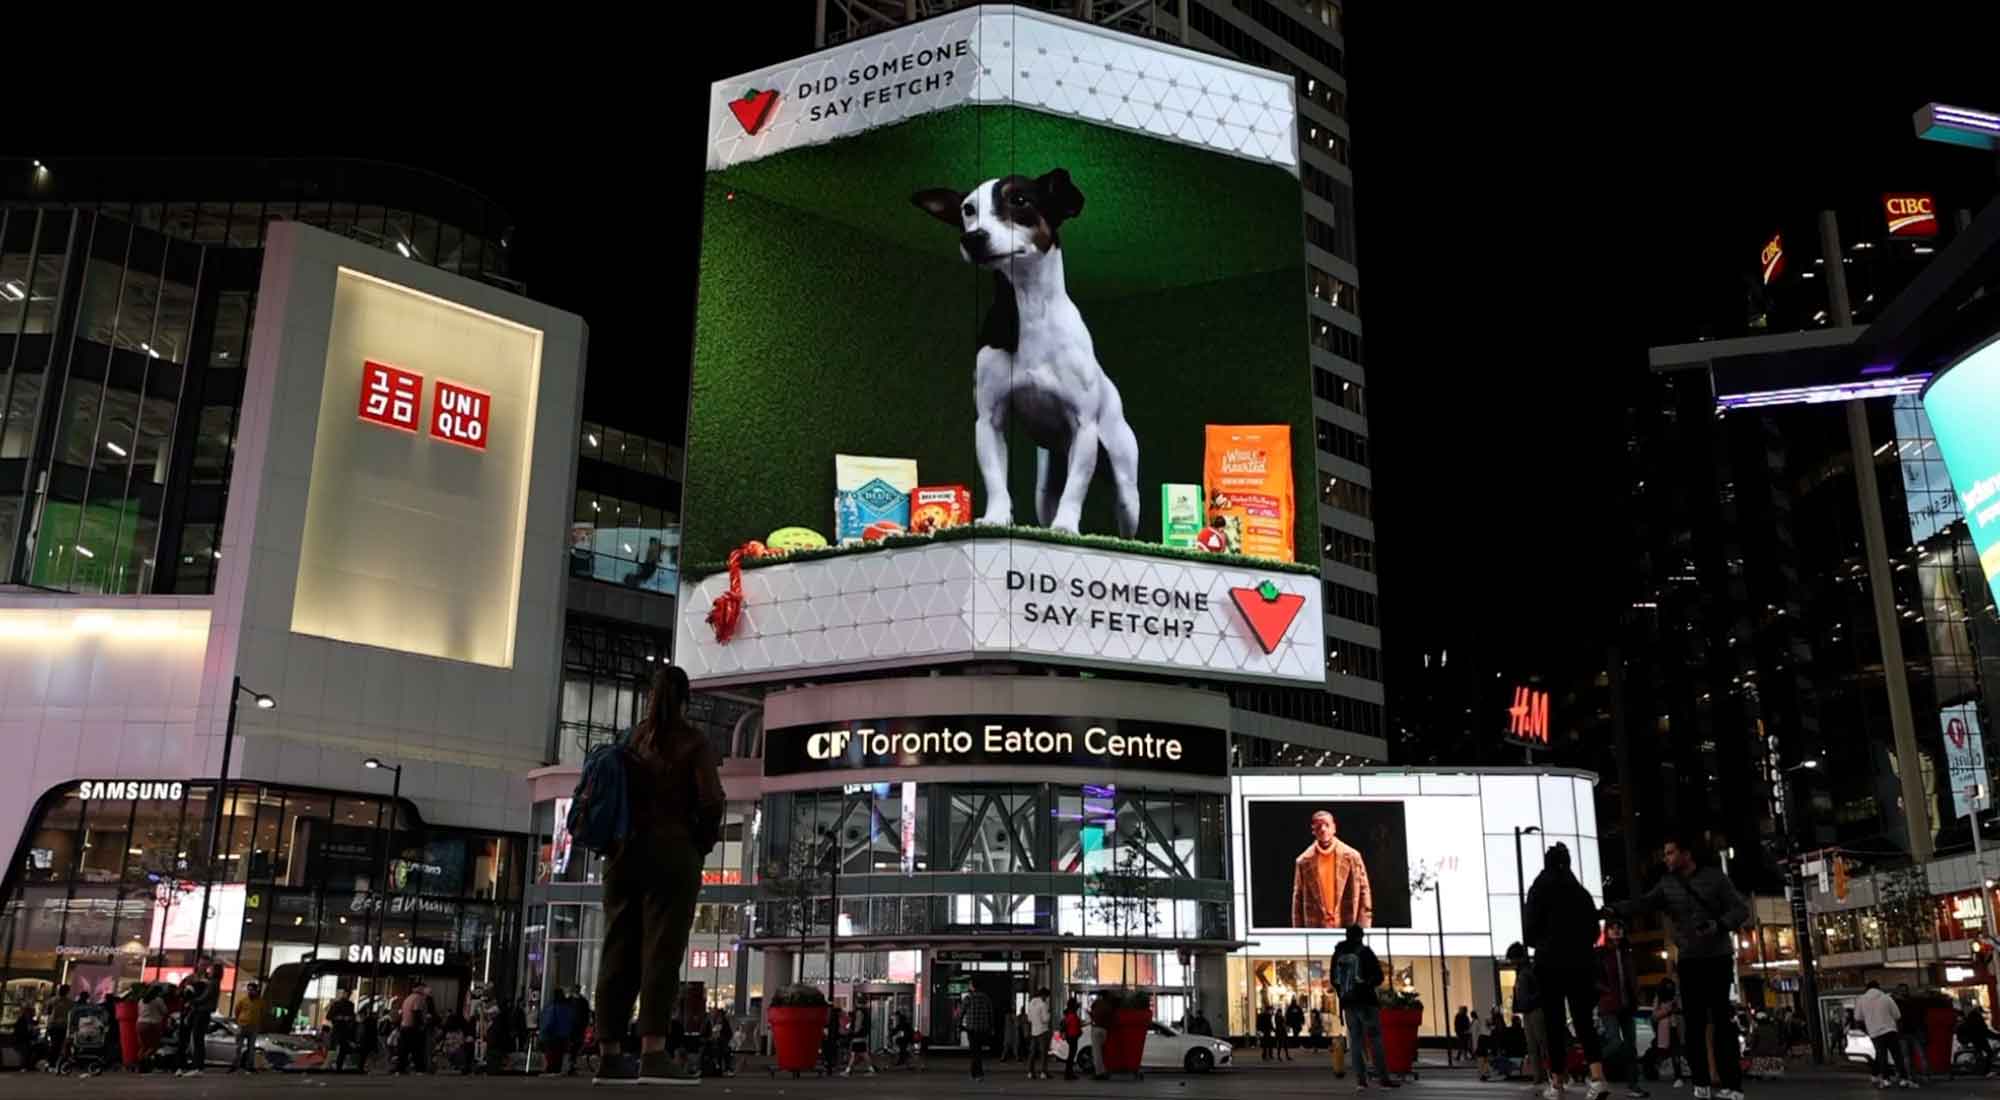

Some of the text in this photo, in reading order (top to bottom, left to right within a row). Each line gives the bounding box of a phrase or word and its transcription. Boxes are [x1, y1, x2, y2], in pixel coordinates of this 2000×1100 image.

[798, 39, 968, 99] DID SOMEONE
[810, 71, 955, 121] SAY FETCH?
[1887, 198, 1932, 214] CIBC
[440, 388, 481, 418] UNI
[438, 412, 482, 440] QLO
[1006, 570, 1209, 612] DID SOMEONE
[1024, 602, 1195, 638] SAY FETCH?
[807, 725, 1182, 761] CF Toronto Eaton Centre
[80, 781, 182, 800] SAMSUNG
